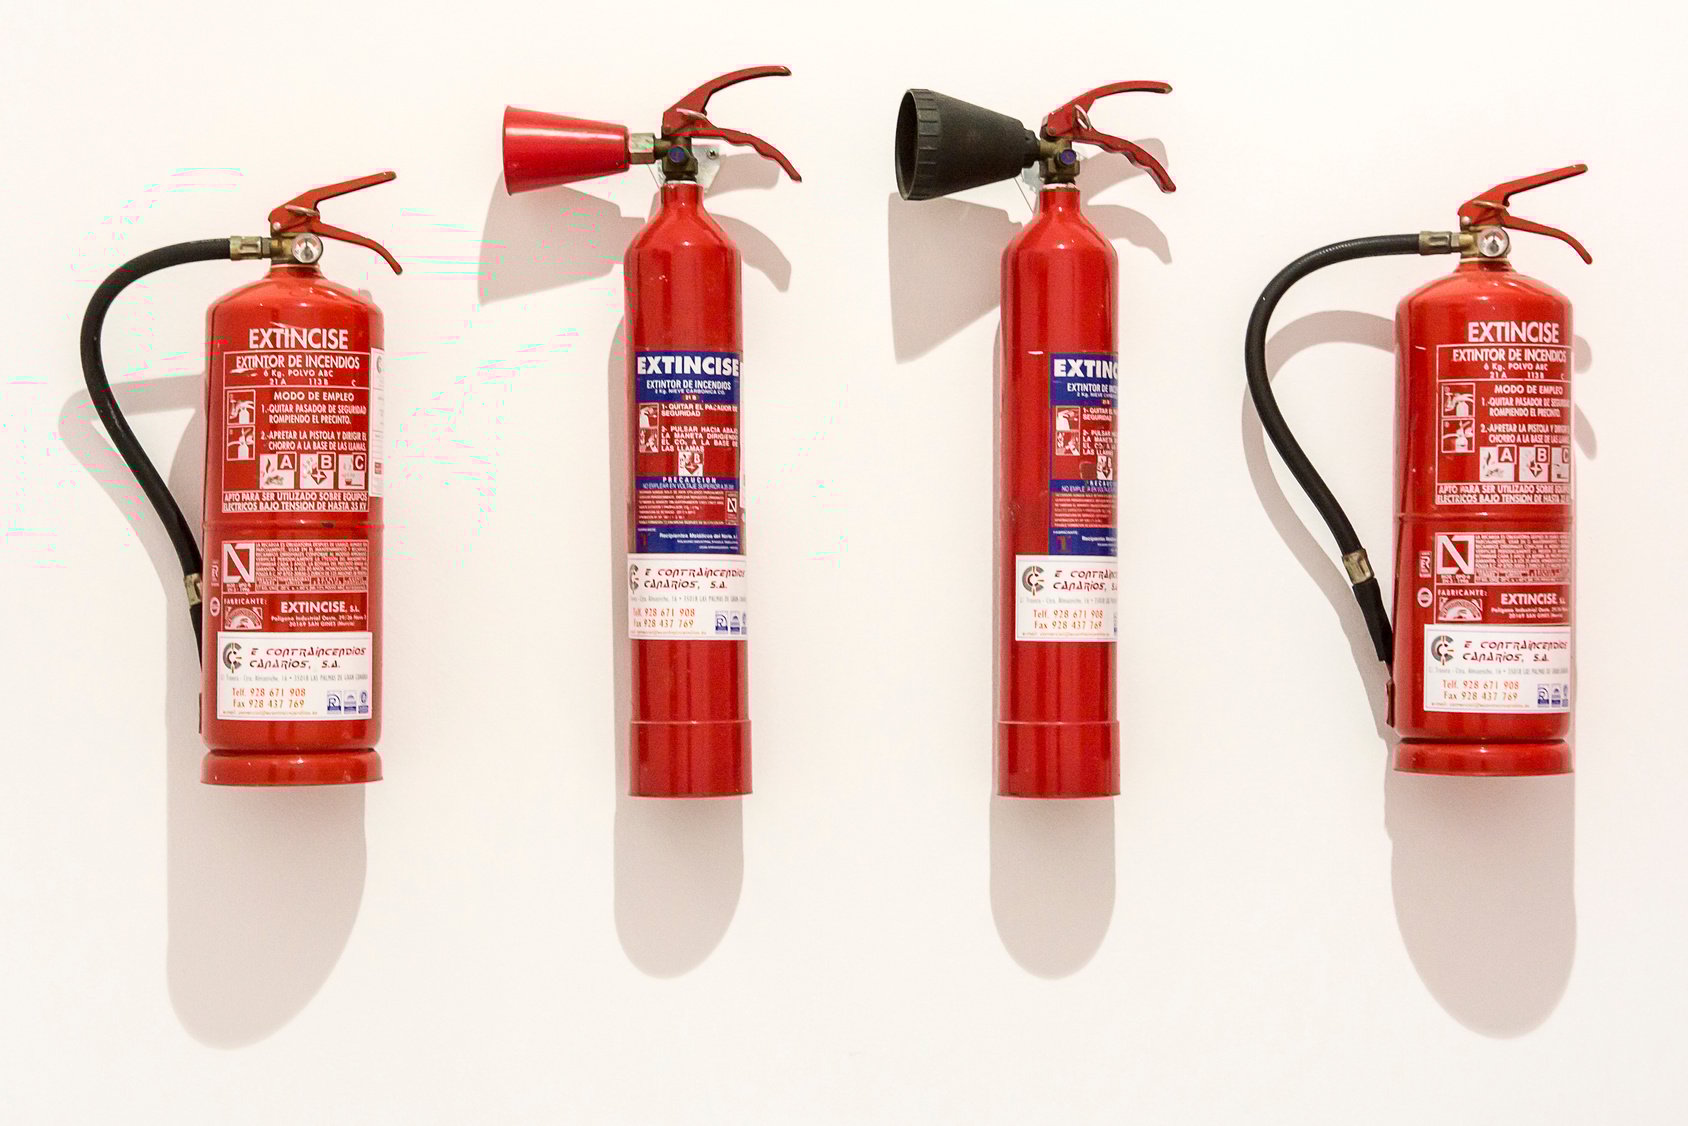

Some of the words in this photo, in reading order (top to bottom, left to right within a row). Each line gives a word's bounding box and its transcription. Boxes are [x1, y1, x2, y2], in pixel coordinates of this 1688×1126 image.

[1468, 322, 1559, 343] EXTINCISE
[249, 328, 349, 349] EXTINCISE
[1453, 349, 1505, 361] EXTINTOR
[1509, 349, 1521, 361] DE
[1525, 350, 1567, 362] INCENDIOS
[236, 356, 284, 368] EXTINTOR
[288, 356, 301, 367] DE
[306, 355, 360, 369] INCENDIOS
[637, 356, 739, 376] EXTINCISE
[647, 380, 680, 389] EXTINTOR
[683, 380, 692, 388] DE
[695, 381, 731, 390] INCENDIOS
[1067, 383, 1100, 392] EXTINTOR
[1494, 385, 1524, 393] MODO
[1539, 386, 1563, 394] EMPLEO
[323, 393, 354, 401] EMPLEO
[1516, 398, 1542, 406] PASADOR
[296, 405, 326, 413] PASADOR
[328, 405, 336, 413] DE
[338, 405, 366, 414] SEGURIDAD
[1490, 408, 1529, 416] ROMPIENDO
[1531, 408, 1537, 416] EL
[269, 415, 309, 423] ROMPIENDO
[312, 415, 319, 423] EL
[1528, 425, 1548, 433] PISTOLA
[309, 431, 335, 439] PISTOLA
[1489, 435, 1515, 443] CHORRO
[1531, 435, 1543, 443] BASE
[269, 442, 295, 450] CHORRO
[313, 442, 327, 450] BASE
[329, 442, 336, 450] DE
[338, 442, 347, 450] LAS
[694, 454, 700, 463] B
[1500, 448, 1513, 461] A
[1537, 449, 1546, 461] B
[280, 455, 292, 468] A
[321, 456, 332, 468] B
[355, 456, 363, 469] C
[1439, 485, 1457, 493] APTO
[1460, 485, 1479, 493] PARA
[1482, 485, 1496, 493] SER
[1498, 485, 1534, 493] UTILIZADO
[1536, 485, 1553, 493] SOBRE
[224, 493, 240, 501] APTO
[242, 493, 260, 501] PARA
[277, 492, 317, 500] UTILIZADO
[319, 492, 341, 500] SOBRE
[343, 492, 367, 500] EQUIPOS
[1438, 494, 1477, 503] ELECTRICOS
[1502, 494, 1533, 503] TENSION
[1535, 495, 1542, 503] DE
[224, 502, 257, 511] ELECTRICOS
[260, 502, 278, 510] BAJO
[282, 502, 314, 510] TENSION
[317, 502, 326, 510] DE
[328, 502, 348, 510] HASTA
[645, 608, 656, 616] 928
[661, 608, 674, 616] 671
[680, 608, 695, 616] 908
[1053, 610, 1068, 618] 928
[1073, 610, 1086, 618] 671
[1091, 610, 1102, 618] 908
[679, 620, 693, 628] 769
[322, 660, 341, 668] S.A.
[1463, 681, 1479, 689] 928
[1484, 681, 1498, 689] 671
[1504, 681, 1519, 689] 908
[250, 688, 265, 696] 928
[269, 688, 284, 696] 671
[1462, 692, 1478, 700] 928
